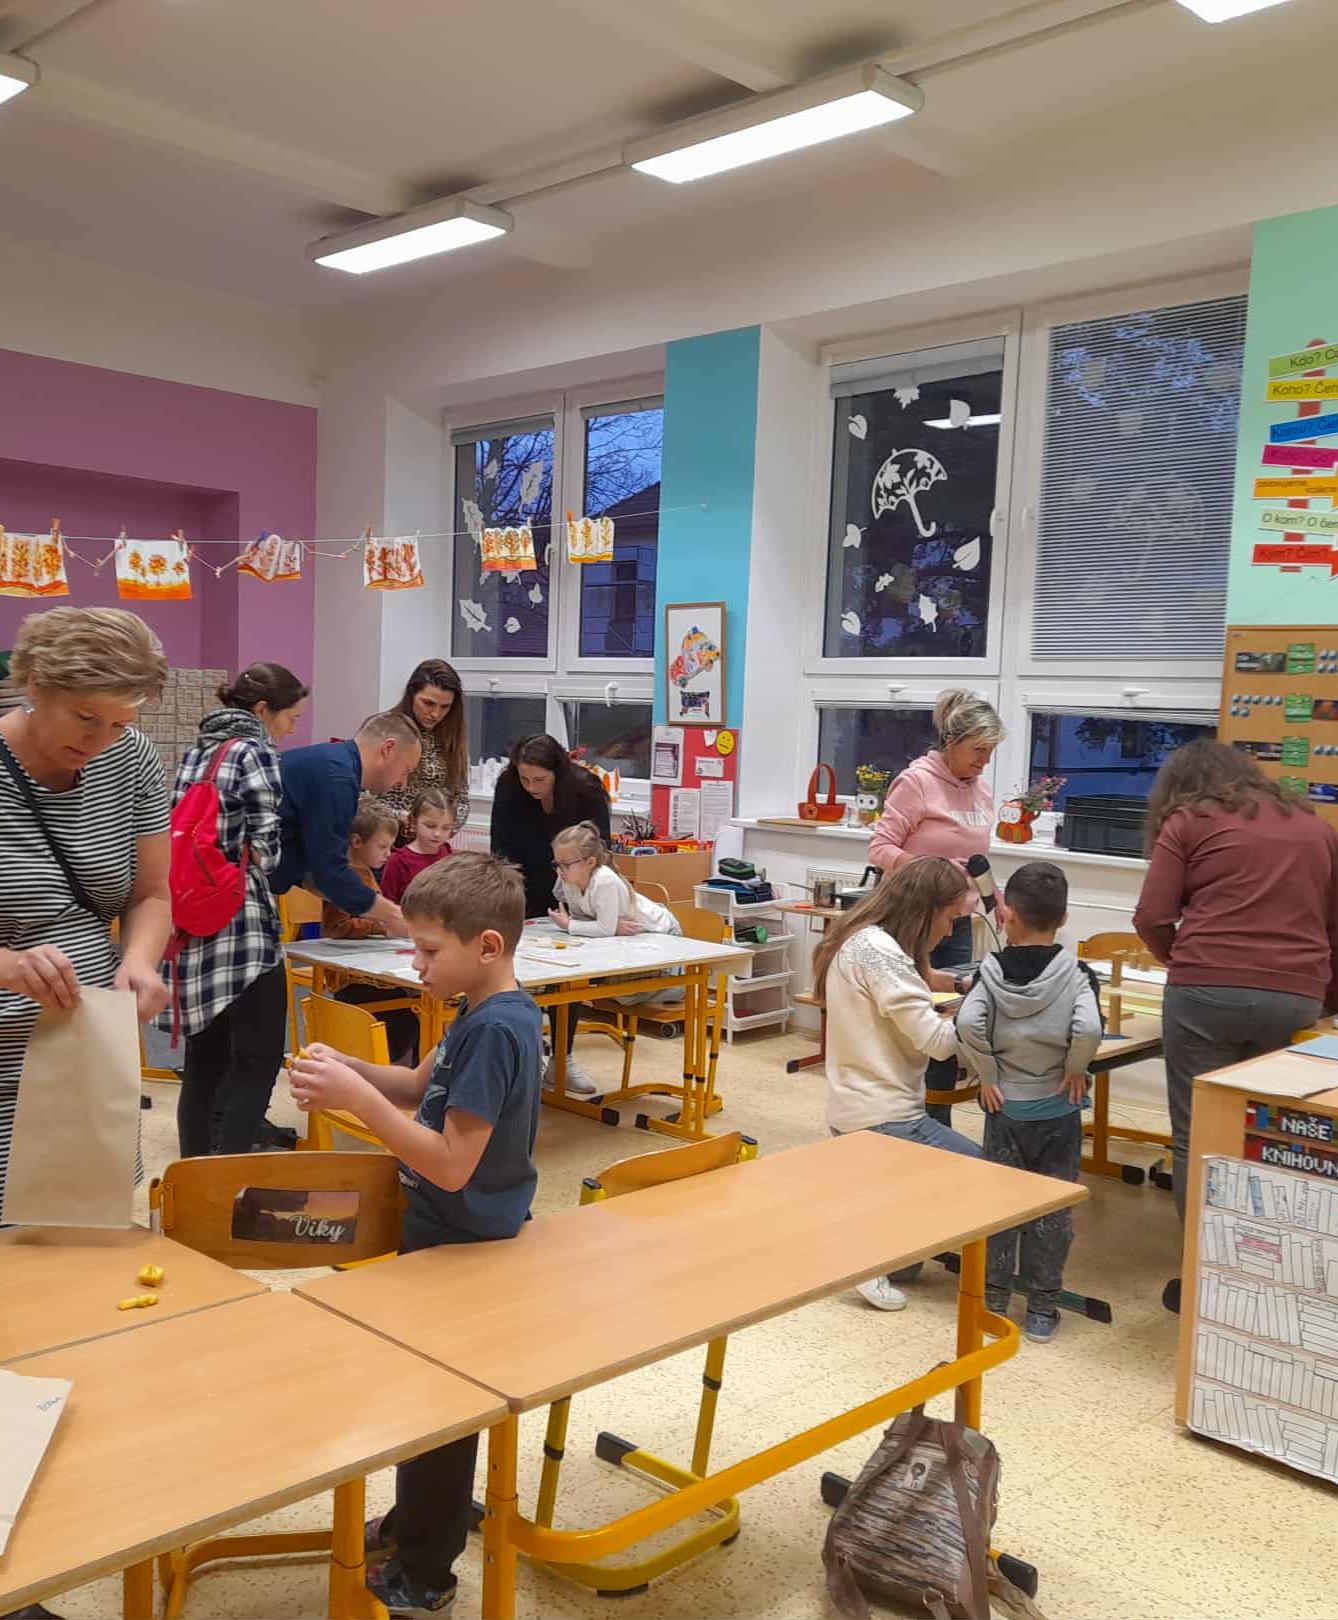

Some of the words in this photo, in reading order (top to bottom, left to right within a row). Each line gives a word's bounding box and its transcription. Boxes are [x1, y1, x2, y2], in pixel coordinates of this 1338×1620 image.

[1273, 384, 1311, 395] Koho?
[1263, 513, 1272, 522] O
[1275, 514, 1304, 526] kom?
[1308, 517, 1317, 527] O
[1281, 1116, 1331, 1141] NAŠE
[289, 1215, 346, 1242] Viky
